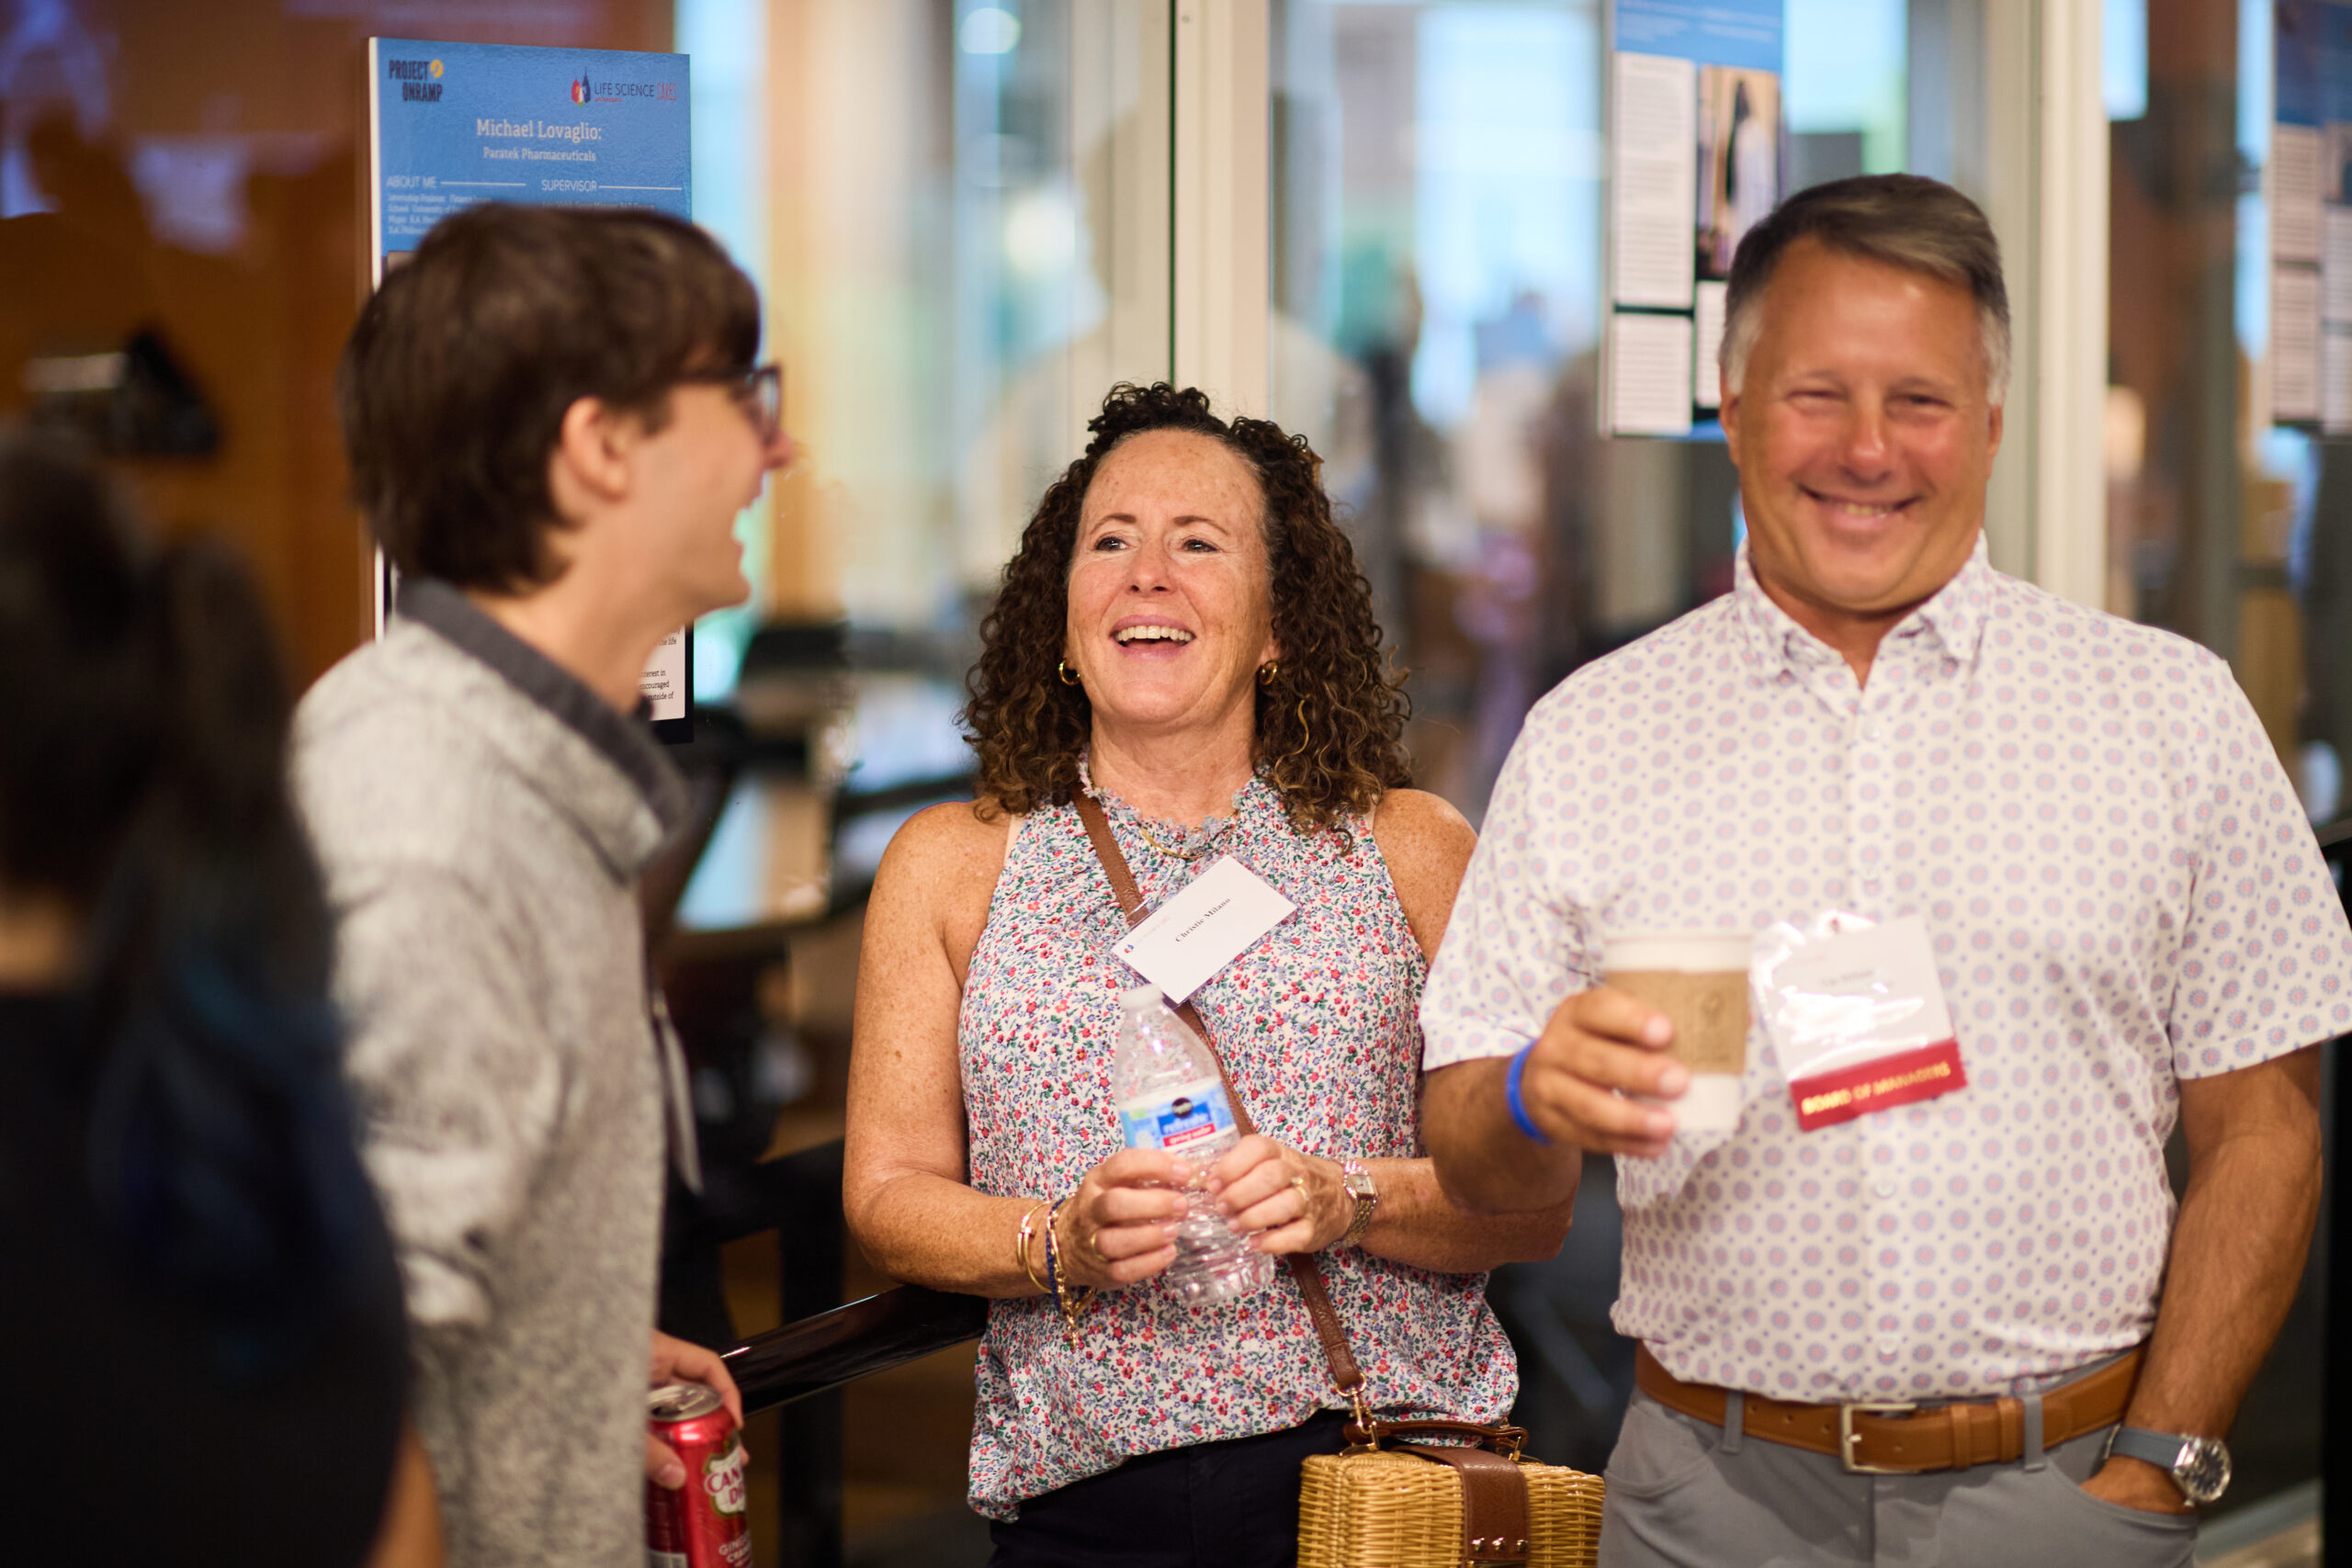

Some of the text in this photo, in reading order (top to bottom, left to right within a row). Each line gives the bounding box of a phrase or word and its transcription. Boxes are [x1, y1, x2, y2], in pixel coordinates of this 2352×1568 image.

[389, 60, 428, 81] PROJECT
[402, 82, 443, 103] ONRAMP
[594, 82, 613, 96] LIFE
[615, 82, 655, 98] SCIENCE
[476, 118, 602, 143] Michael Lovaglio:
[483, 146, 596, 162] Paratek Pharmaceuticals
[386, 175, 437, 189] ABOUT ME
[541, 179, 597, 192] SUPERVISOR
[639, 680, 670, 691] encouraged
[668, 691, 674, 700] of
[1175, 919, 1205, 942] Christie
[1204, 897, 1232, 919] Milano
[1801, 1059, 1951, 1115] BOARD OF MANAGERS
